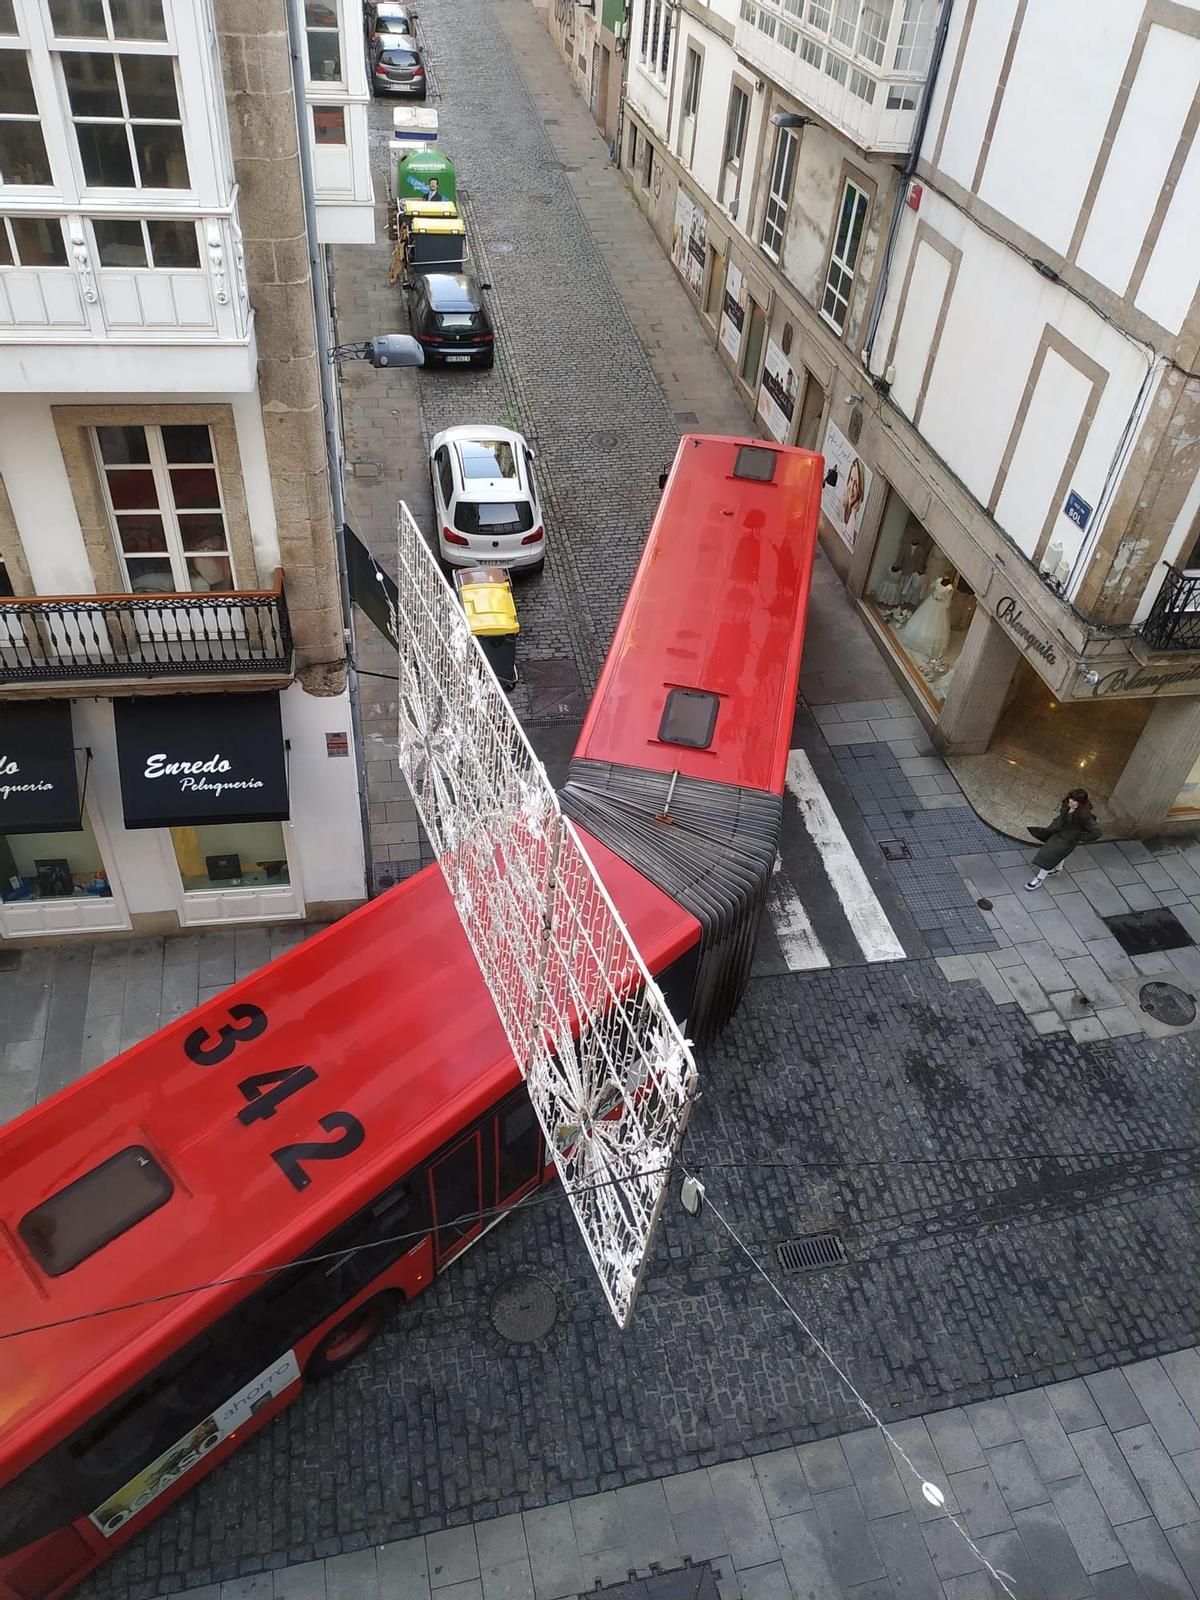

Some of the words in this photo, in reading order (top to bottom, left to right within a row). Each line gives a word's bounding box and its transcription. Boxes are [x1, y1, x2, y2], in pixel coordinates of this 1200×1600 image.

[1068, 508, 1081, 525] SOL
[995, 596, 1057, 666] Blanquita
[143, 753, 232, 779] Enredo
[0, 780, 54, 799] quería
[180, 777, 264, 797] Peluquería
[223, 1362, 290, 1421] ahorro
[102, 1430, 224, 1530] OCASO
